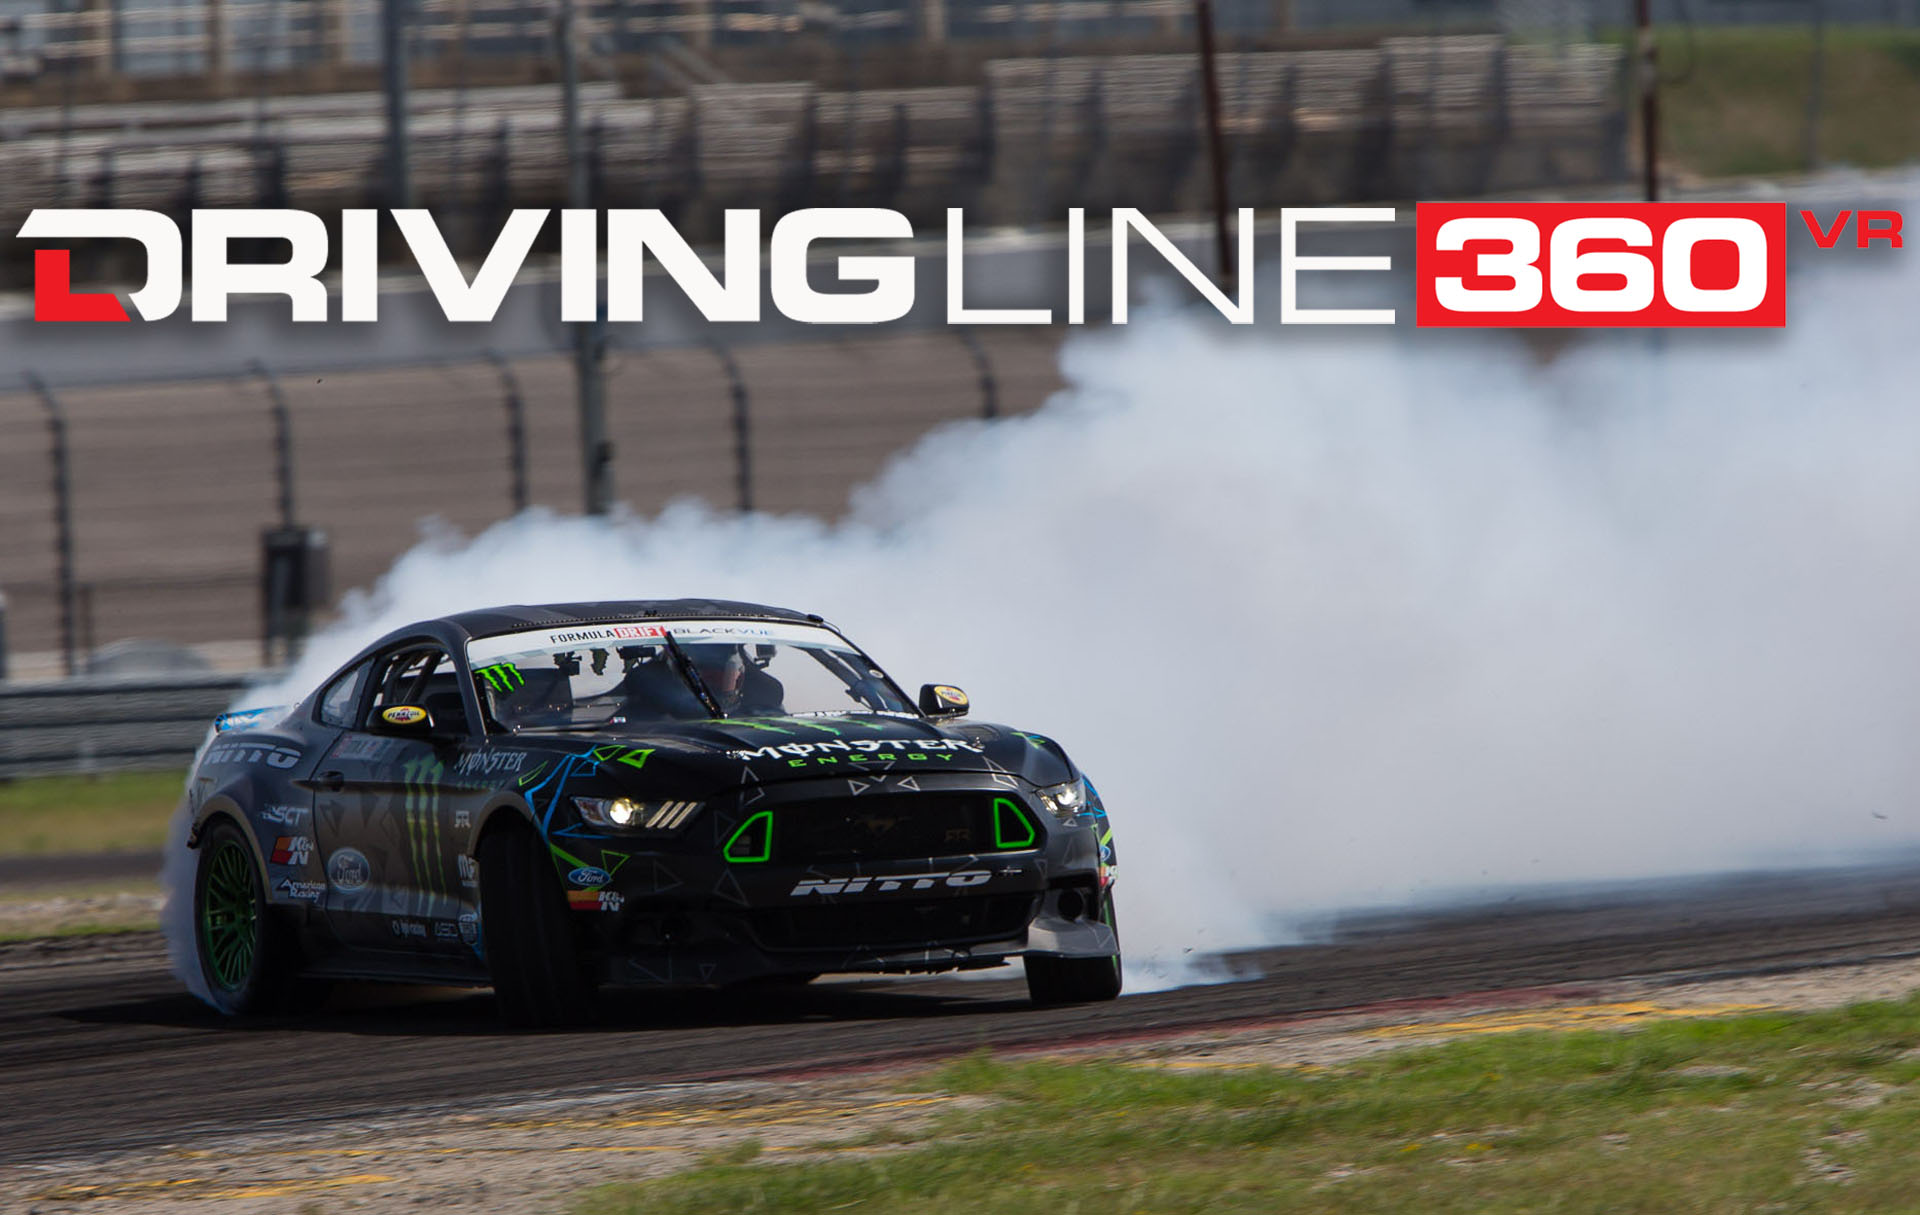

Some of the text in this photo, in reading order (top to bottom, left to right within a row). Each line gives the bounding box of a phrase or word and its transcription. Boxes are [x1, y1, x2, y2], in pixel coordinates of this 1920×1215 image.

[550, 625, 666, 644] FORMULA DRIFT
[741, 738, 984, 761] MONSTER
[788, 753, 953, 768] ENERGY
[790, 869, 993, 897] NITTO
